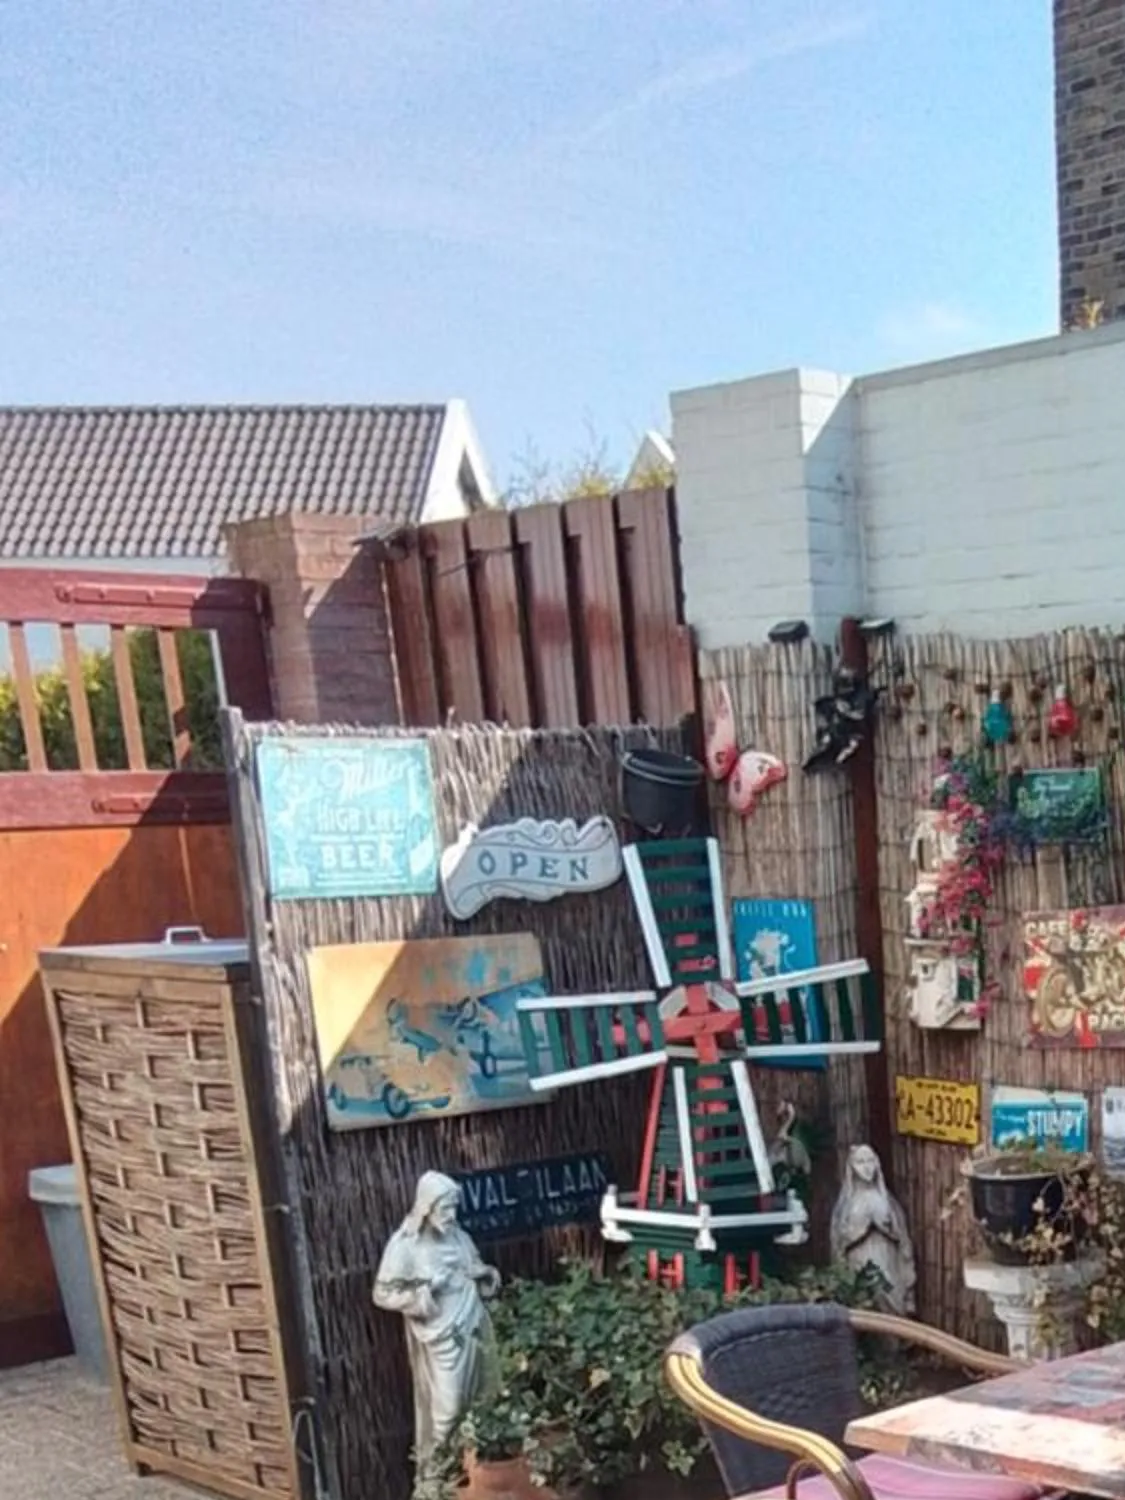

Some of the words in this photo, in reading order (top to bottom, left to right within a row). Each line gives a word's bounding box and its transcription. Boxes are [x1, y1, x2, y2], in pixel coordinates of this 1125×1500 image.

[321, 843, 394, 869] BEER
[478, 849, 590, 882] OPEN
[1026, 920, 1069, 936] CAFE
